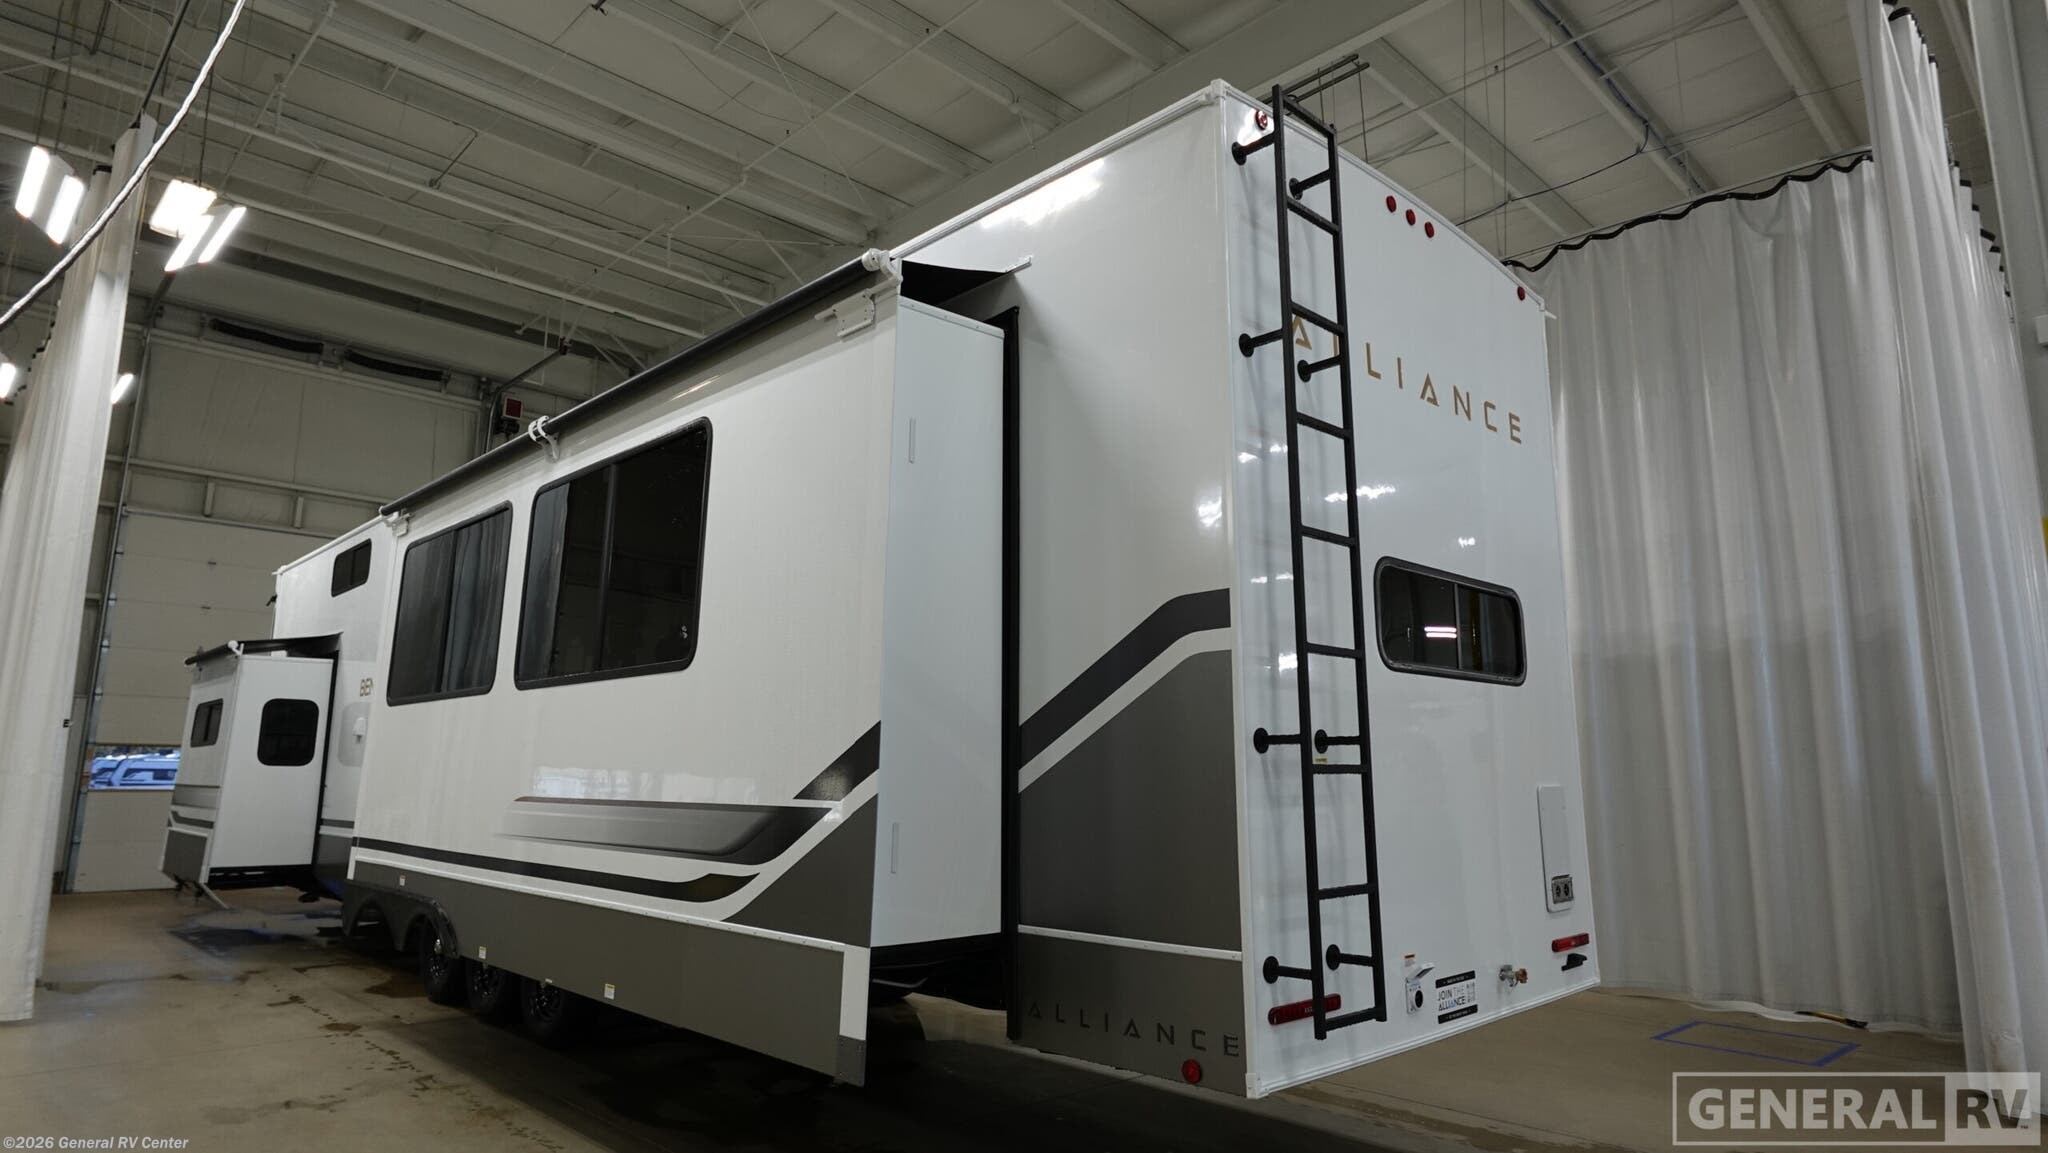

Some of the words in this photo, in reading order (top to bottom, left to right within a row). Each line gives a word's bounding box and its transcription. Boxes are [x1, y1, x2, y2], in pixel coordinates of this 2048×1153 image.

[1438, 989, 1452, 1002] JOIN
[1439, 995, 1466, 1011] ALLIANCE
[1028, 1001, 1239, 1057] ALLIANCE
